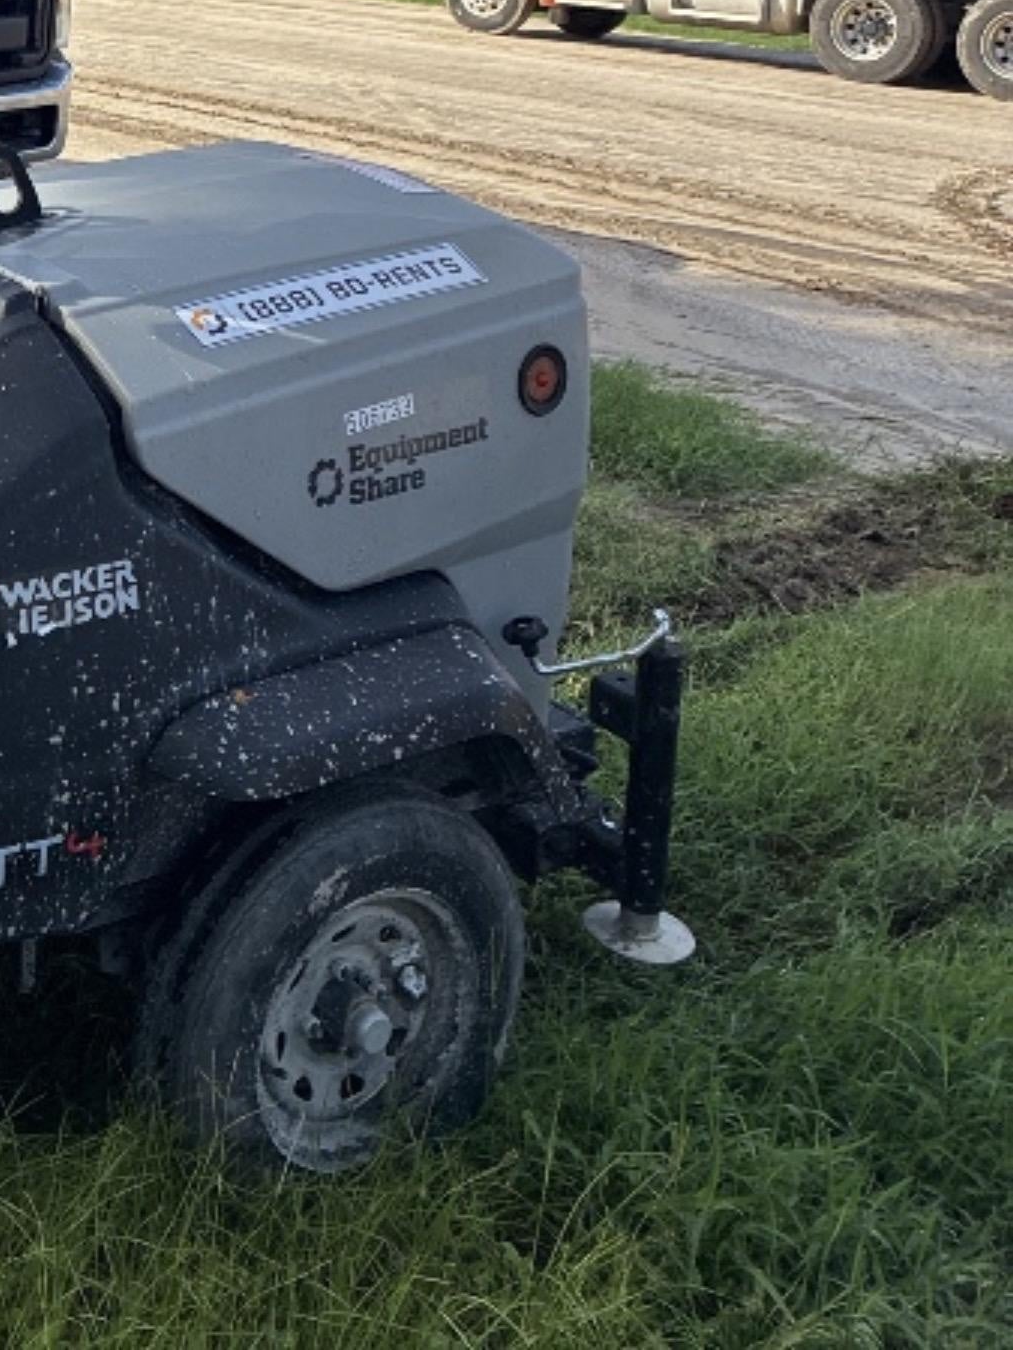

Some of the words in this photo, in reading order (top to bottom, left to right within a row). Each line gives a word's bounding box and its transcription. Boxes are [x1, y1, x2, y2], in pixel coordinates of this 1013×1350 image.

[238, 287, 325, 321] (888)
[347, 417, 490, 473] Equipment
[349, 468, 426, 505] Share
